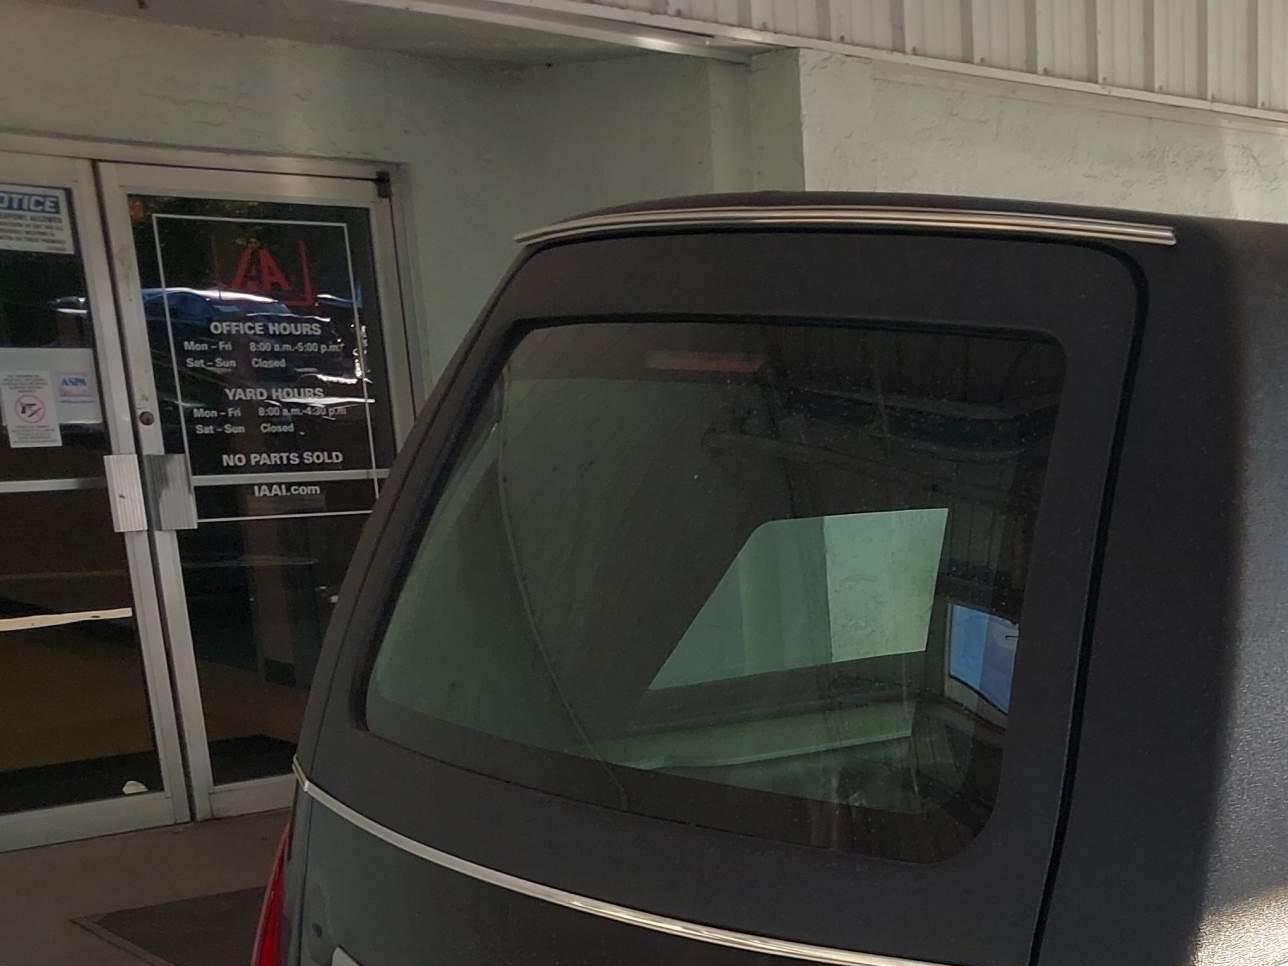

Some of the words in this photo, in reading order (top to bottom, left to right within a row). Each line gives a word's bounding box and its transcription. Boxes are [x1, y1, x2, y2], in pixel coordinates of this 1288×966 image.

[210, 321, 265, 335] OFFICE
[268, 323, 322, 336] HOURS
[184, 341, 208, 350] Mon
[219, 341, 232, 350] Fri
[249, 342, 272, 352] 8:00
[186, 358, 204, 368] Sat
[215, 358, 236, 368] Sun
[252, 358, 286, 368] Closed
[224, 388, 267, 400] YARD
[272, 388, 325, 401] HOURS
[193, 408, 218, 418] Mon
[227, 407, 241, 417] Fri
[258, 407, 280, 417] 8:00
[195, 424, 214, 434] Sat
[224, 423, 245, 434] Sun
[260, 423, 295, 433] Closed
[222, 455, 246, 466] NO
[251, 453, 300, 465] PARTS
[303, 452, 343, 463] SOLD
[254, 484, 320, 497] IAAI.com
